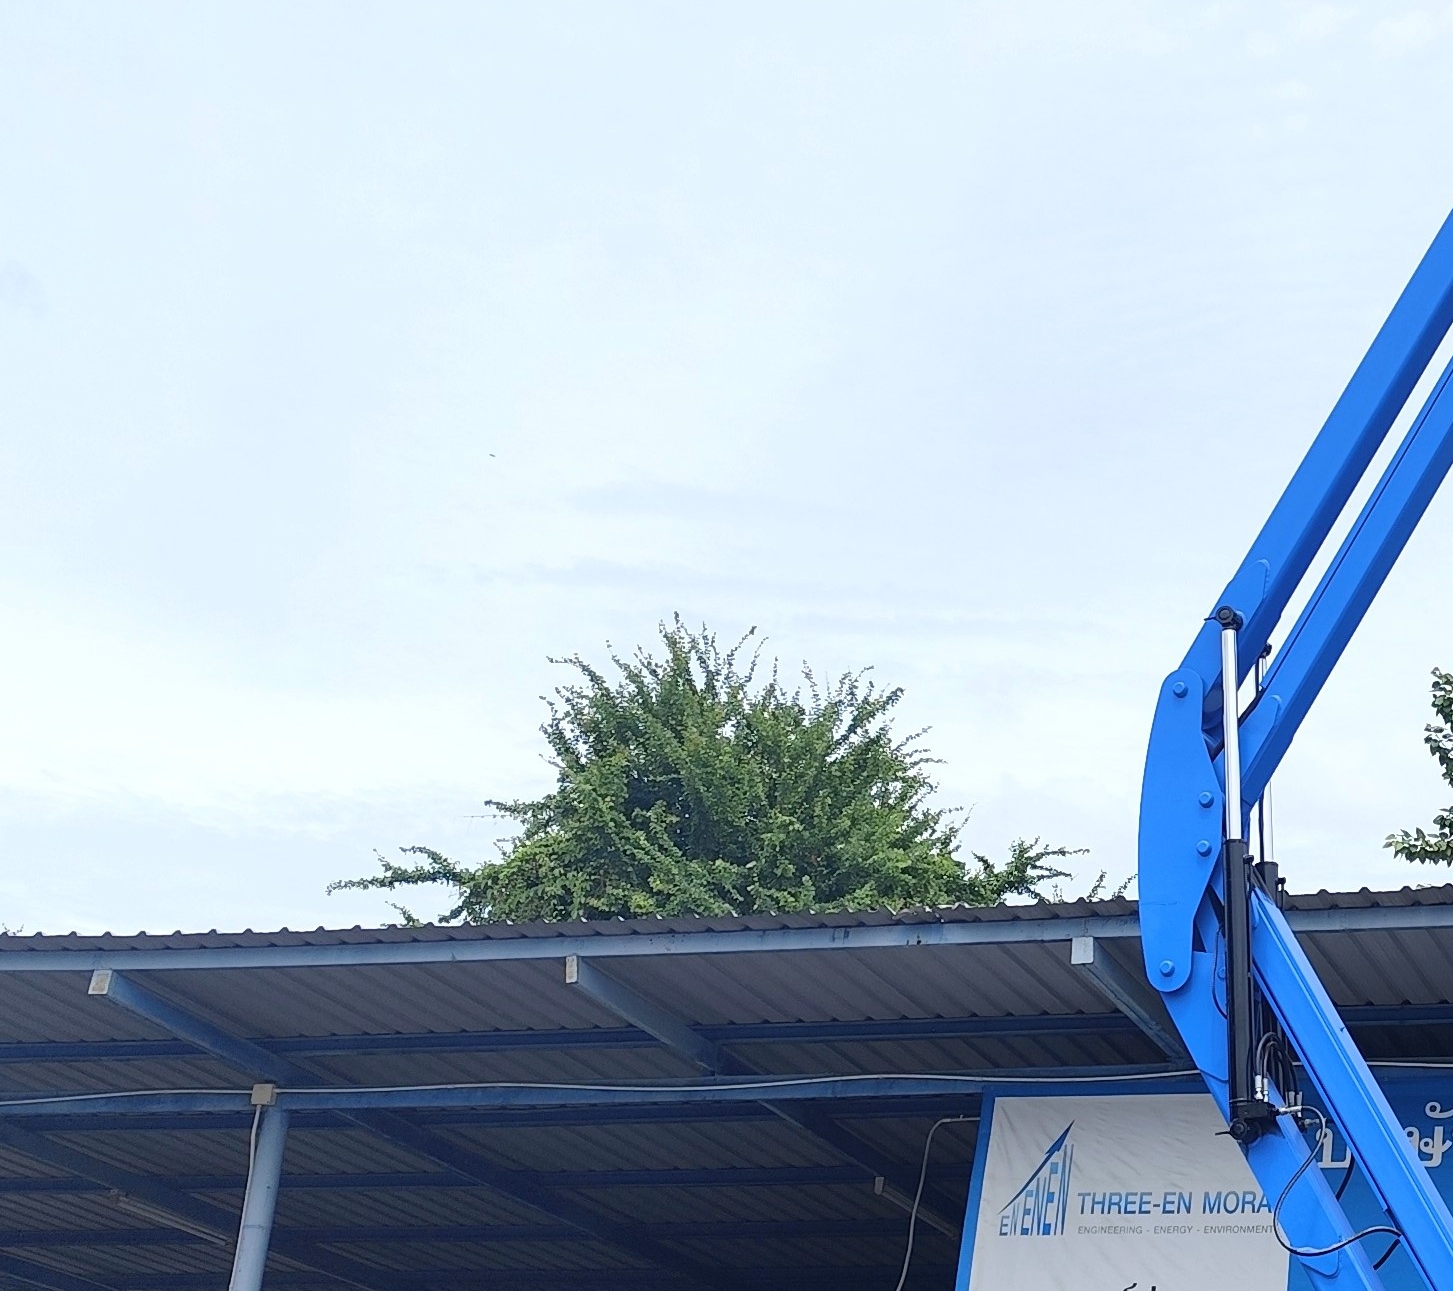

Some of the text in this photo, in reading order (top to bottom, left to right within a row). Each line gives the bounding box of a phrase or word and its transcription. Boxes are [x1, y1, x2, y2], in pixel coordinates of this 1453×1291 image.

[1077, 1191, 1273, 1215] THREE-EN MORA
[1077, 1225, 1143, 1235] ENGINEERING
[1153, 1225, 1193, 1234] ENERGY
[1203, 1224, 1274, 1234] ENVIRONMENT
